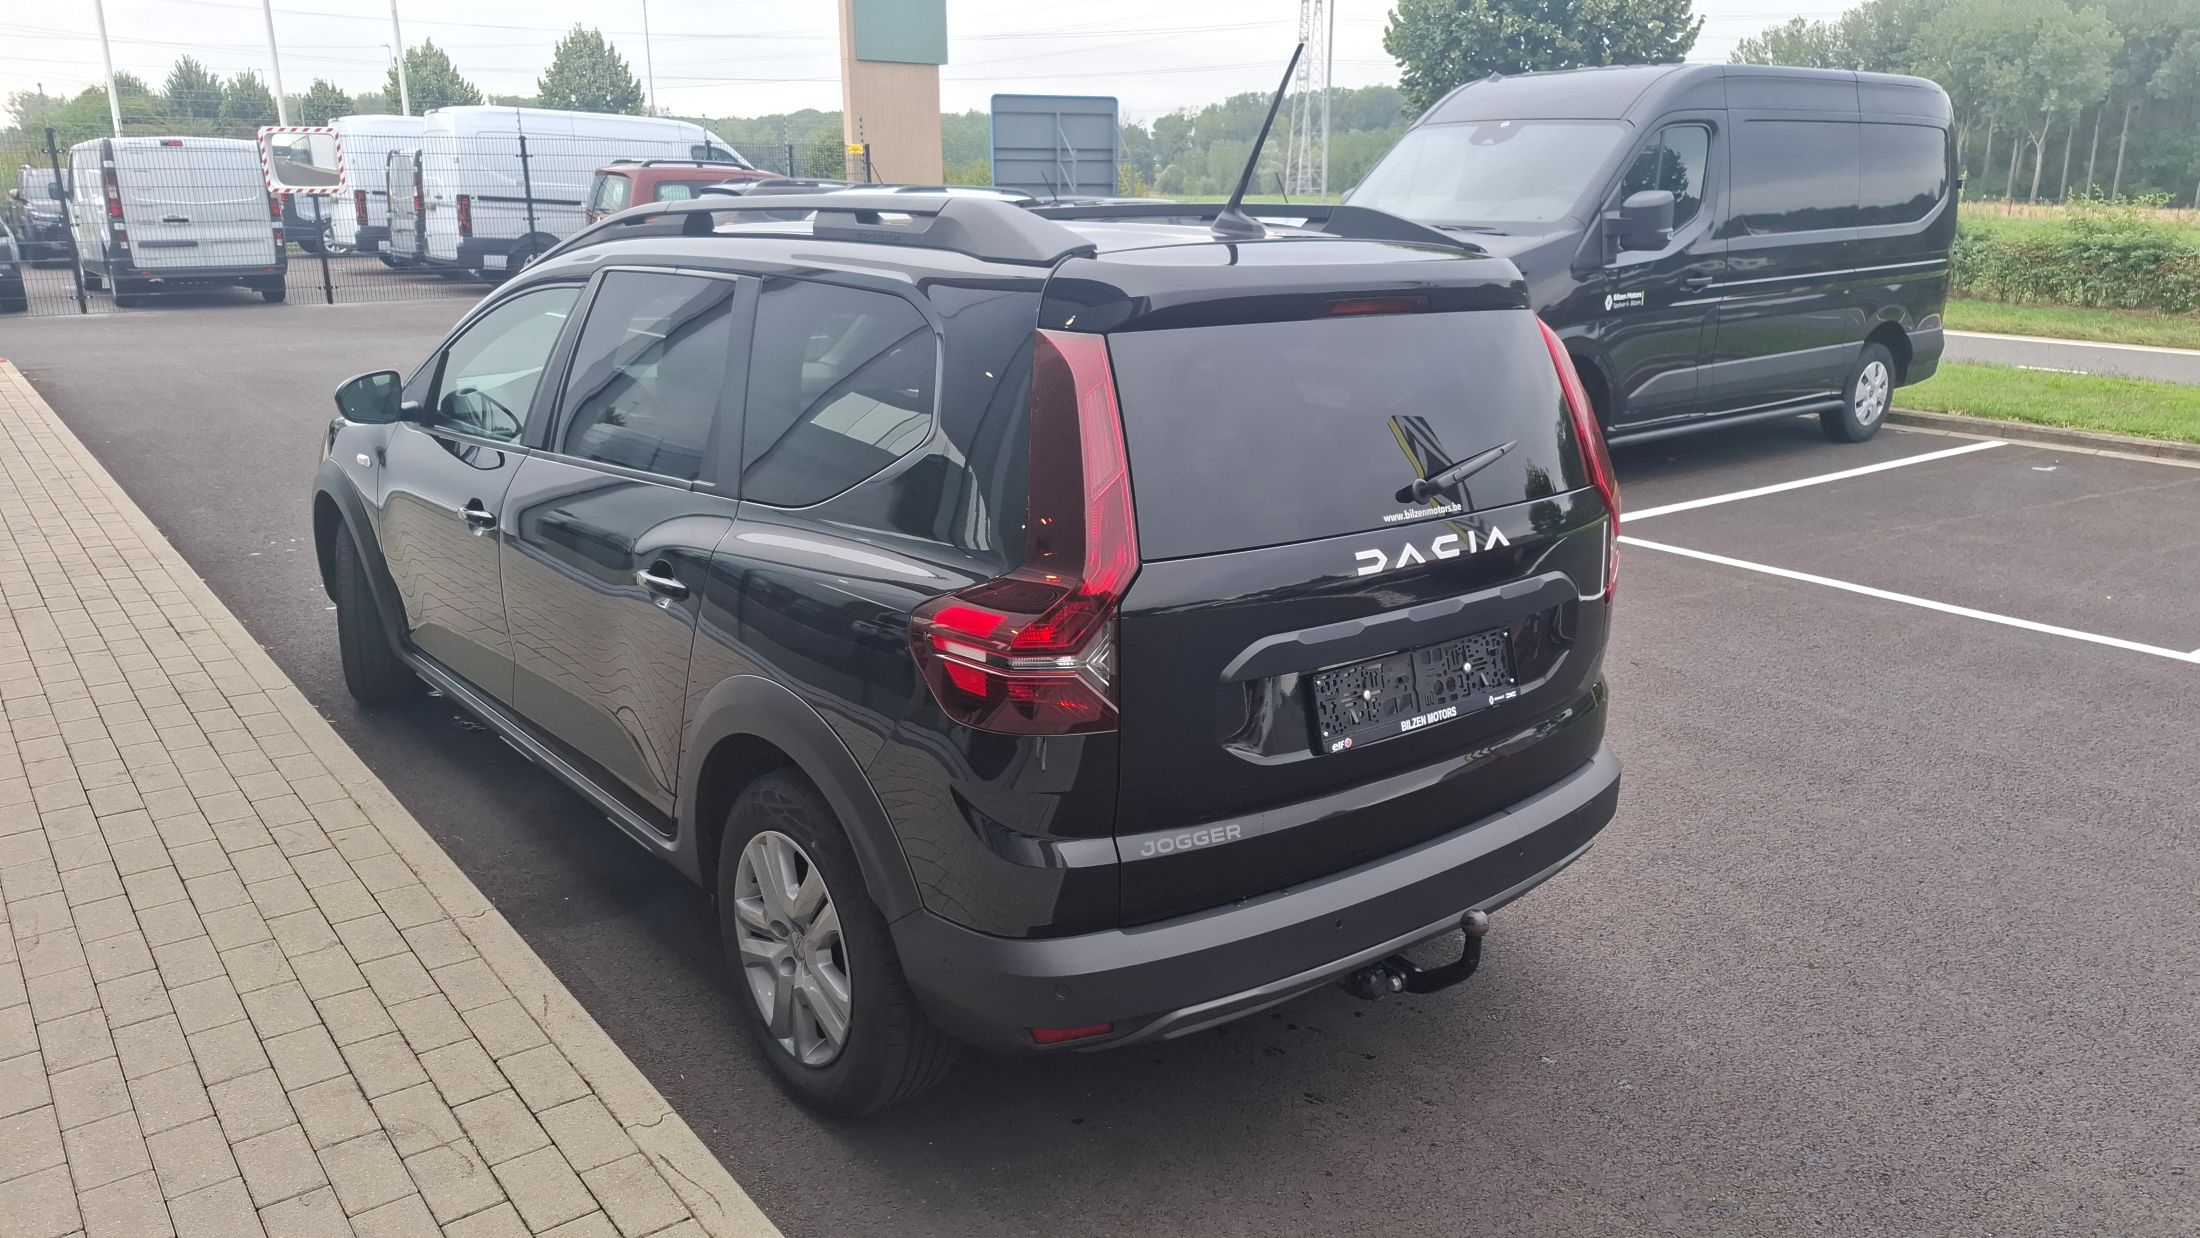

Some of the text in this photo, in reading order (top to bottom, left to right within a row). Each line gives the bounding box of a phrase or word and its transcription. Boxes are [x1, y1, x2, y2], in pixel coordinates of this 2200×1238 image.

[1383, 502, 1462, 523] www.bilzenmotors.be
[1354, 526, 1511, 576] DACIA
[1401, 706, 1457, 732] BILZEN MOTORS
[1331, 739, 1345, 752] elf
[1140, 824, 1242, 857] JOGGER
